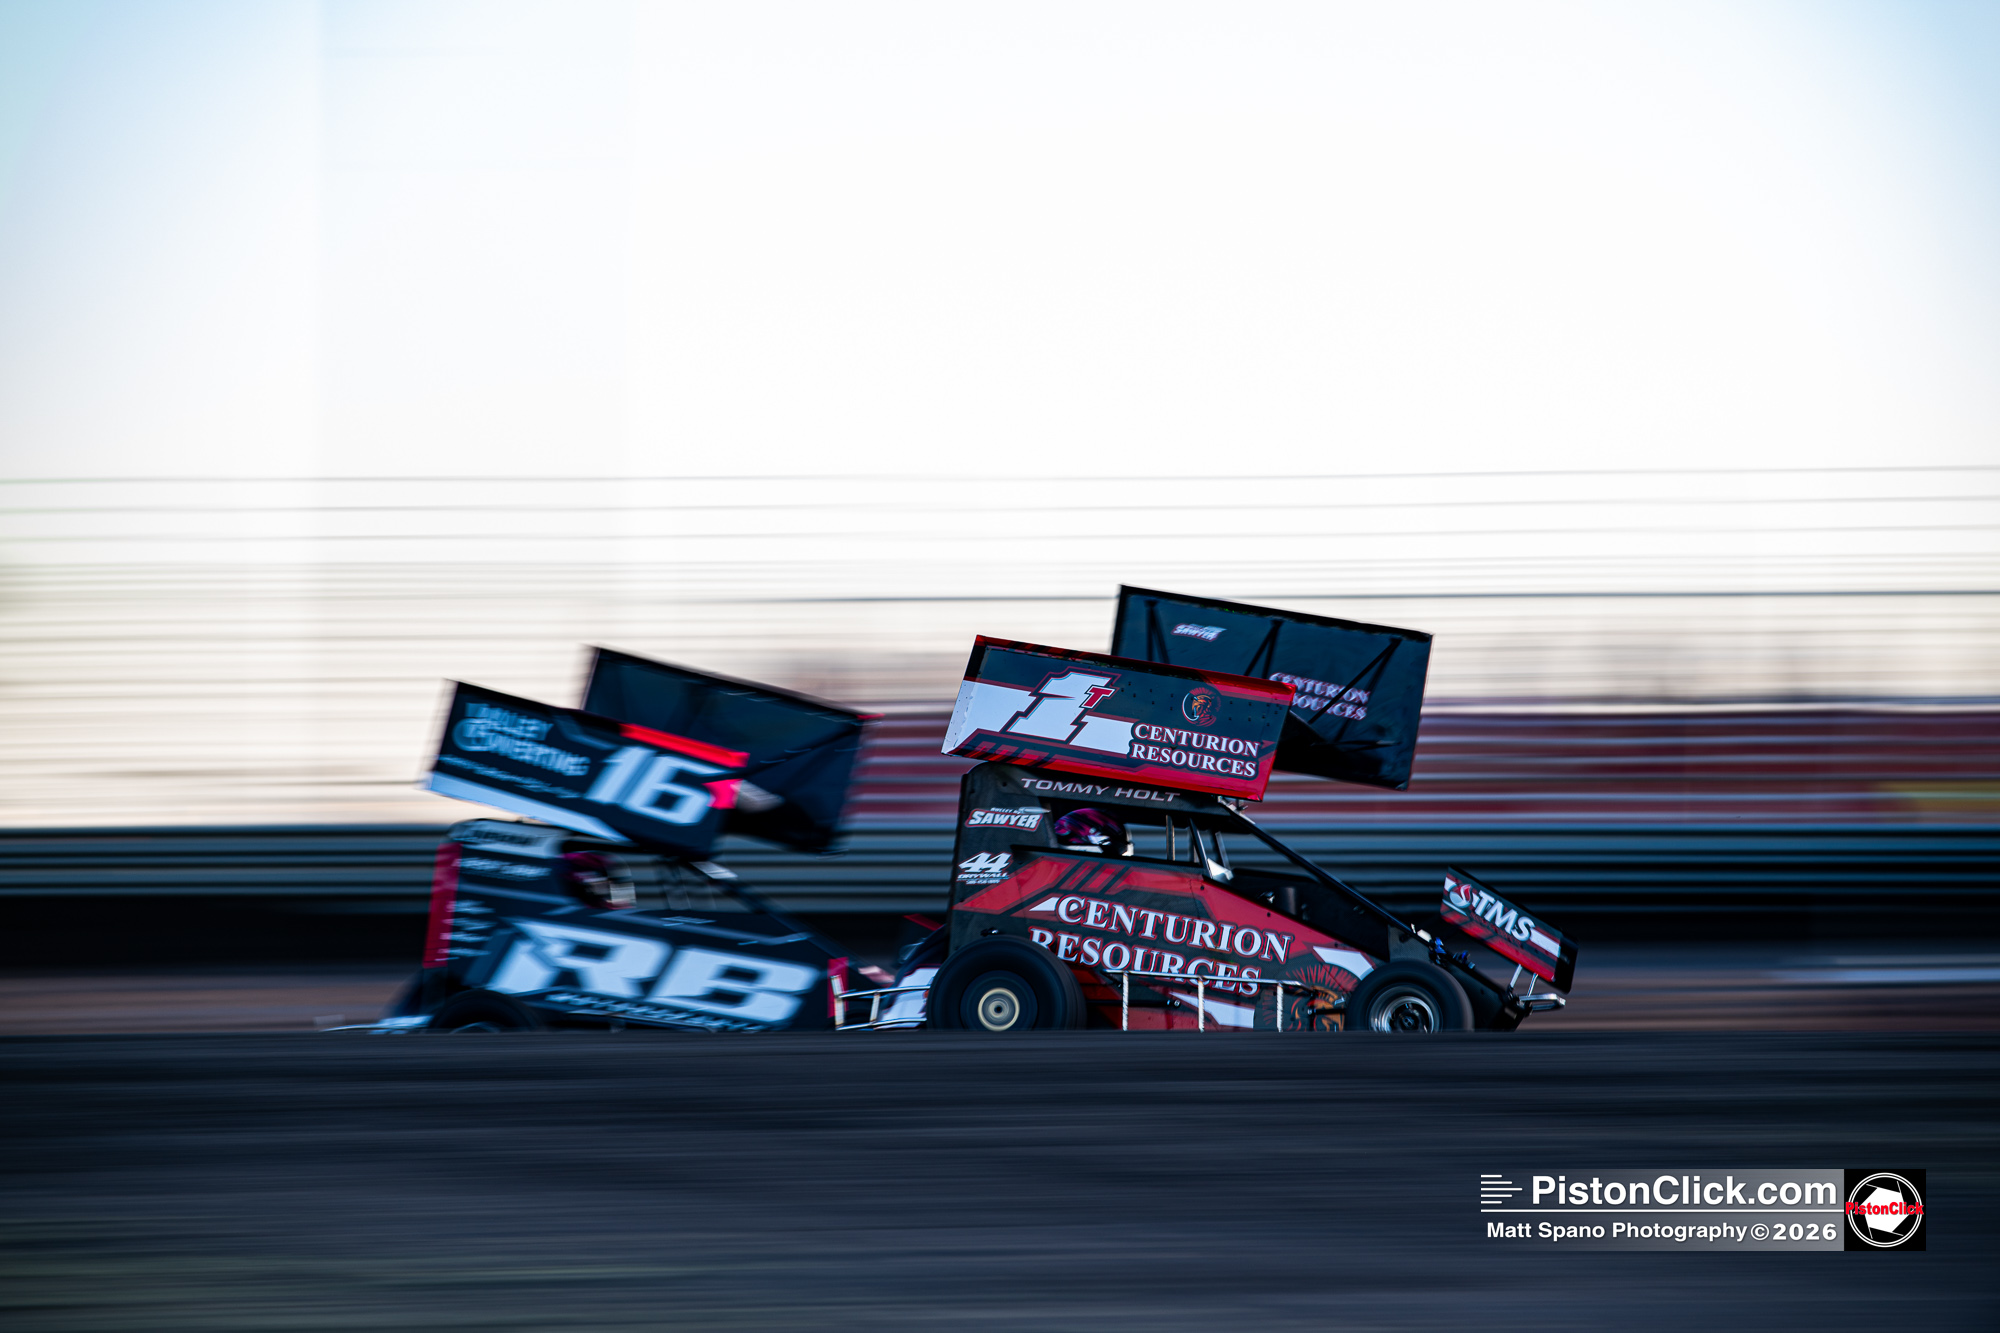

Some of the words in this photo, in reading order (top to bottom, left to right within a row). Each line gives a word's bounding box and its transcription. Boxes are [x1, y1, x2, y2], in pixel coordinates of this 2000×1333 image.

[1134, 723, 1260, 757] CENTURION
[1132, 743, 1257, 777] RESOURCES
[1021, 778, 1109, 795] TOMMY
[1114, 787, 1180, 802] HOLT
[968, 811, 1041, 829] SAWYER
[959, 852, 1011, 872] 44
[1057, 896, 1291, 963] CENTURION
[1475, 890, 1535, 941] TMS
[1030, 928, 1260, 995] RESOURCES
